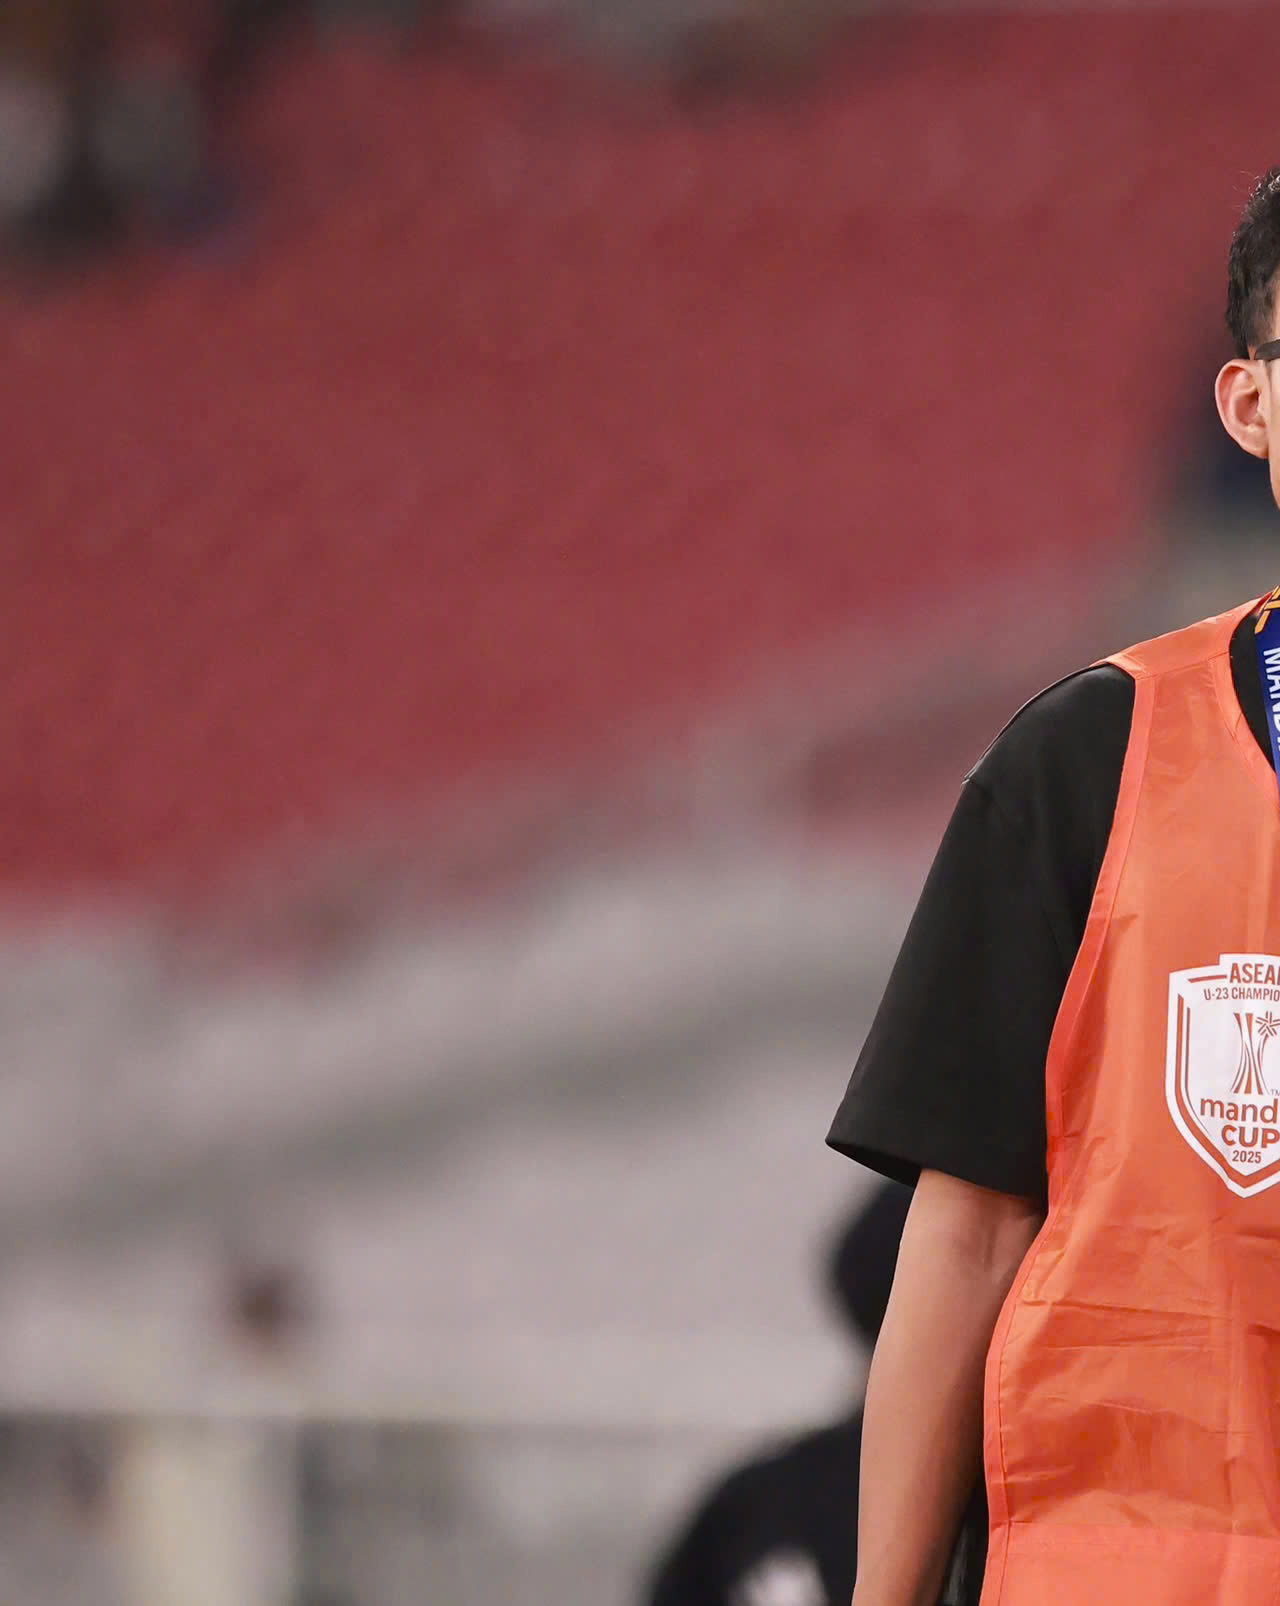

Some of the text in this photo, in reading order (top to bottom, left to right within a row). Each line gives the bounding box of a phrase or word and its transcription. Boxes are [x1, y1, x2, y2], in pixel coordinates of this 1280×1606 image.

[1203, 987, 1229, 1001] U-23
[1221, 1124, 1280, 1148] CUP
[1232, 1150, 1262, 1163] 2025
